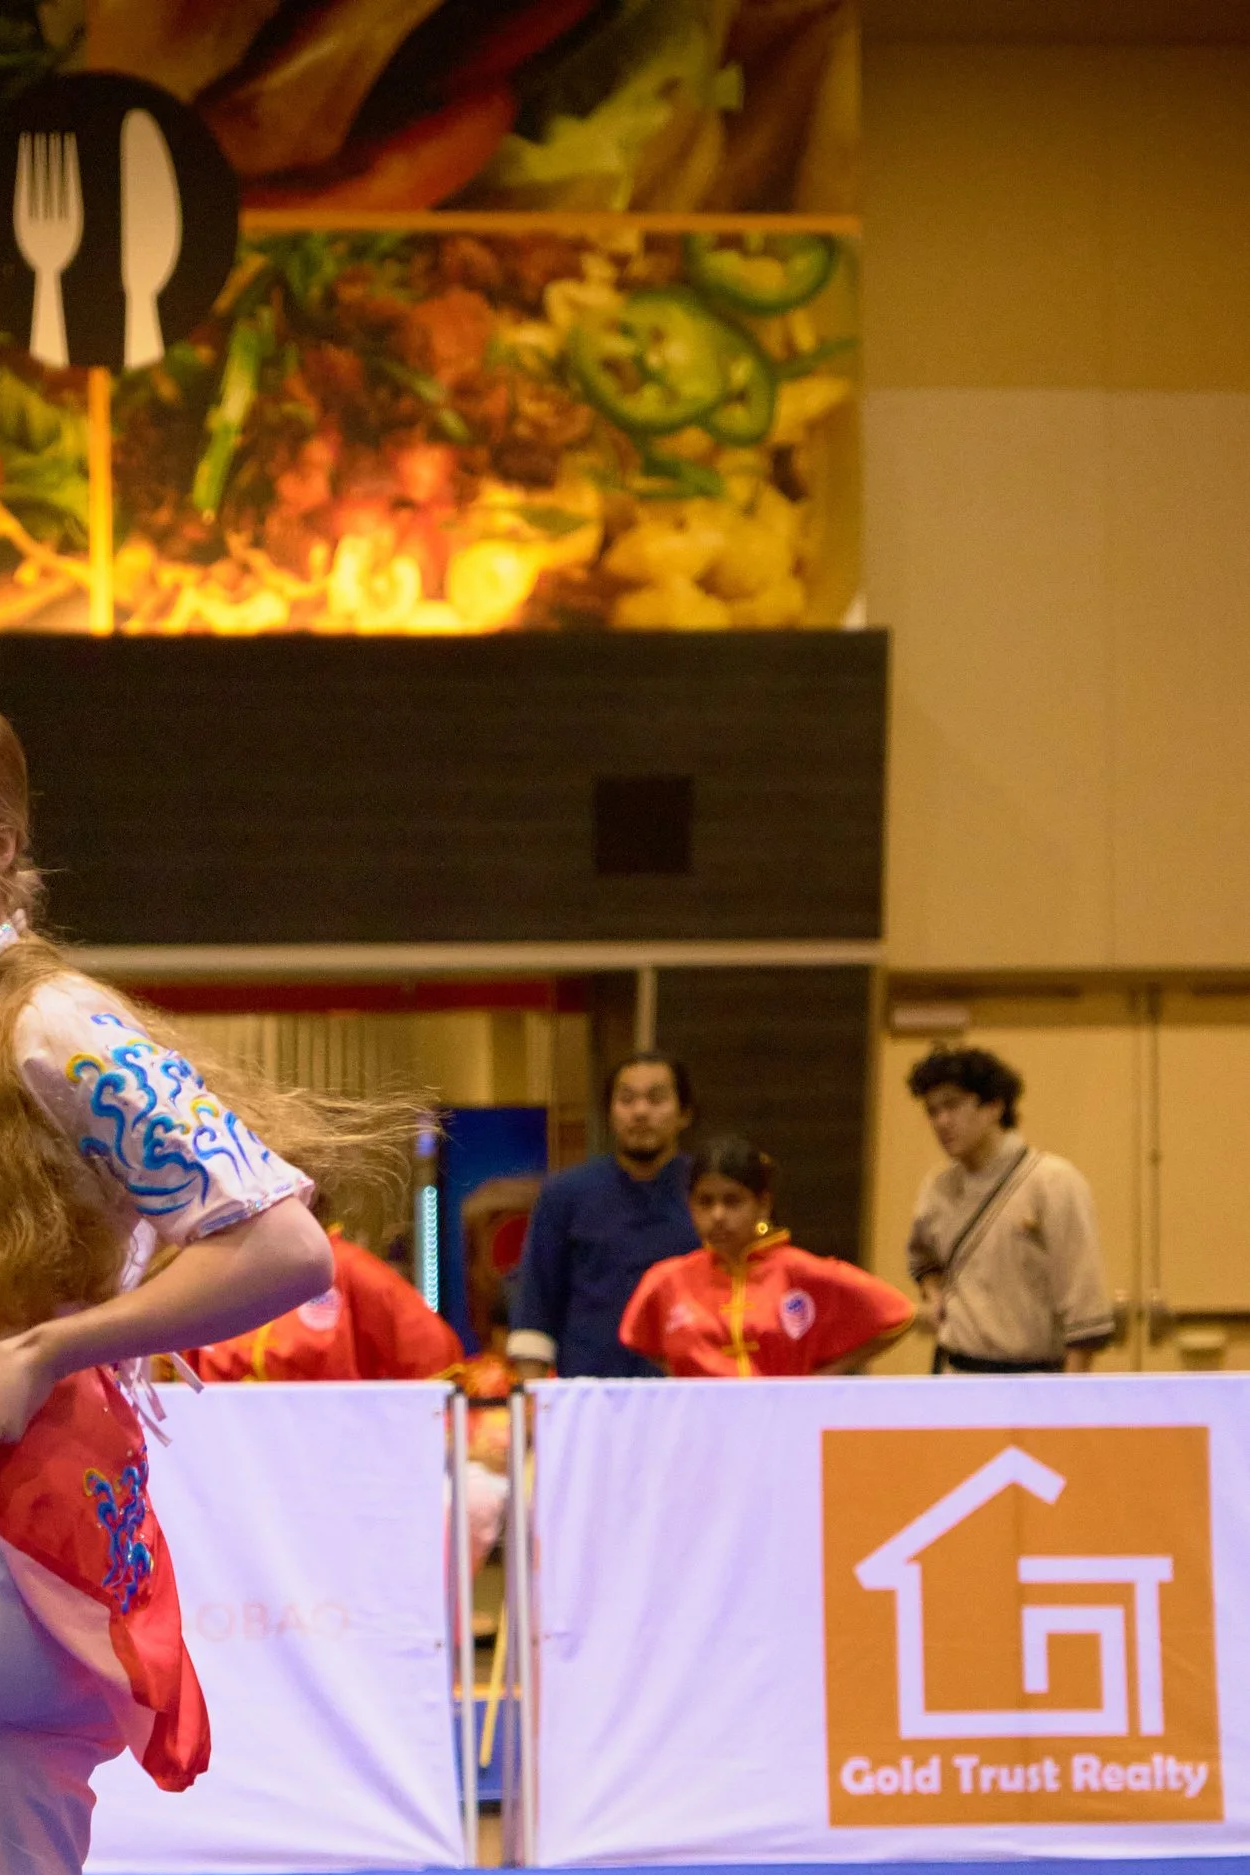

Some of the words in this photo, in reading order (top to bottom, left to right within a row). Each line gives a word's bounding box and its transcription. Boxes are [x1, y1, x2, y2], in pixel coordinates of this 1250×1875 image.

[840, 1755, 941, 1795] Gold
[953, 1754, 1061, 1793] Trust
[1071, 1752, 1208, 1799] Realty
